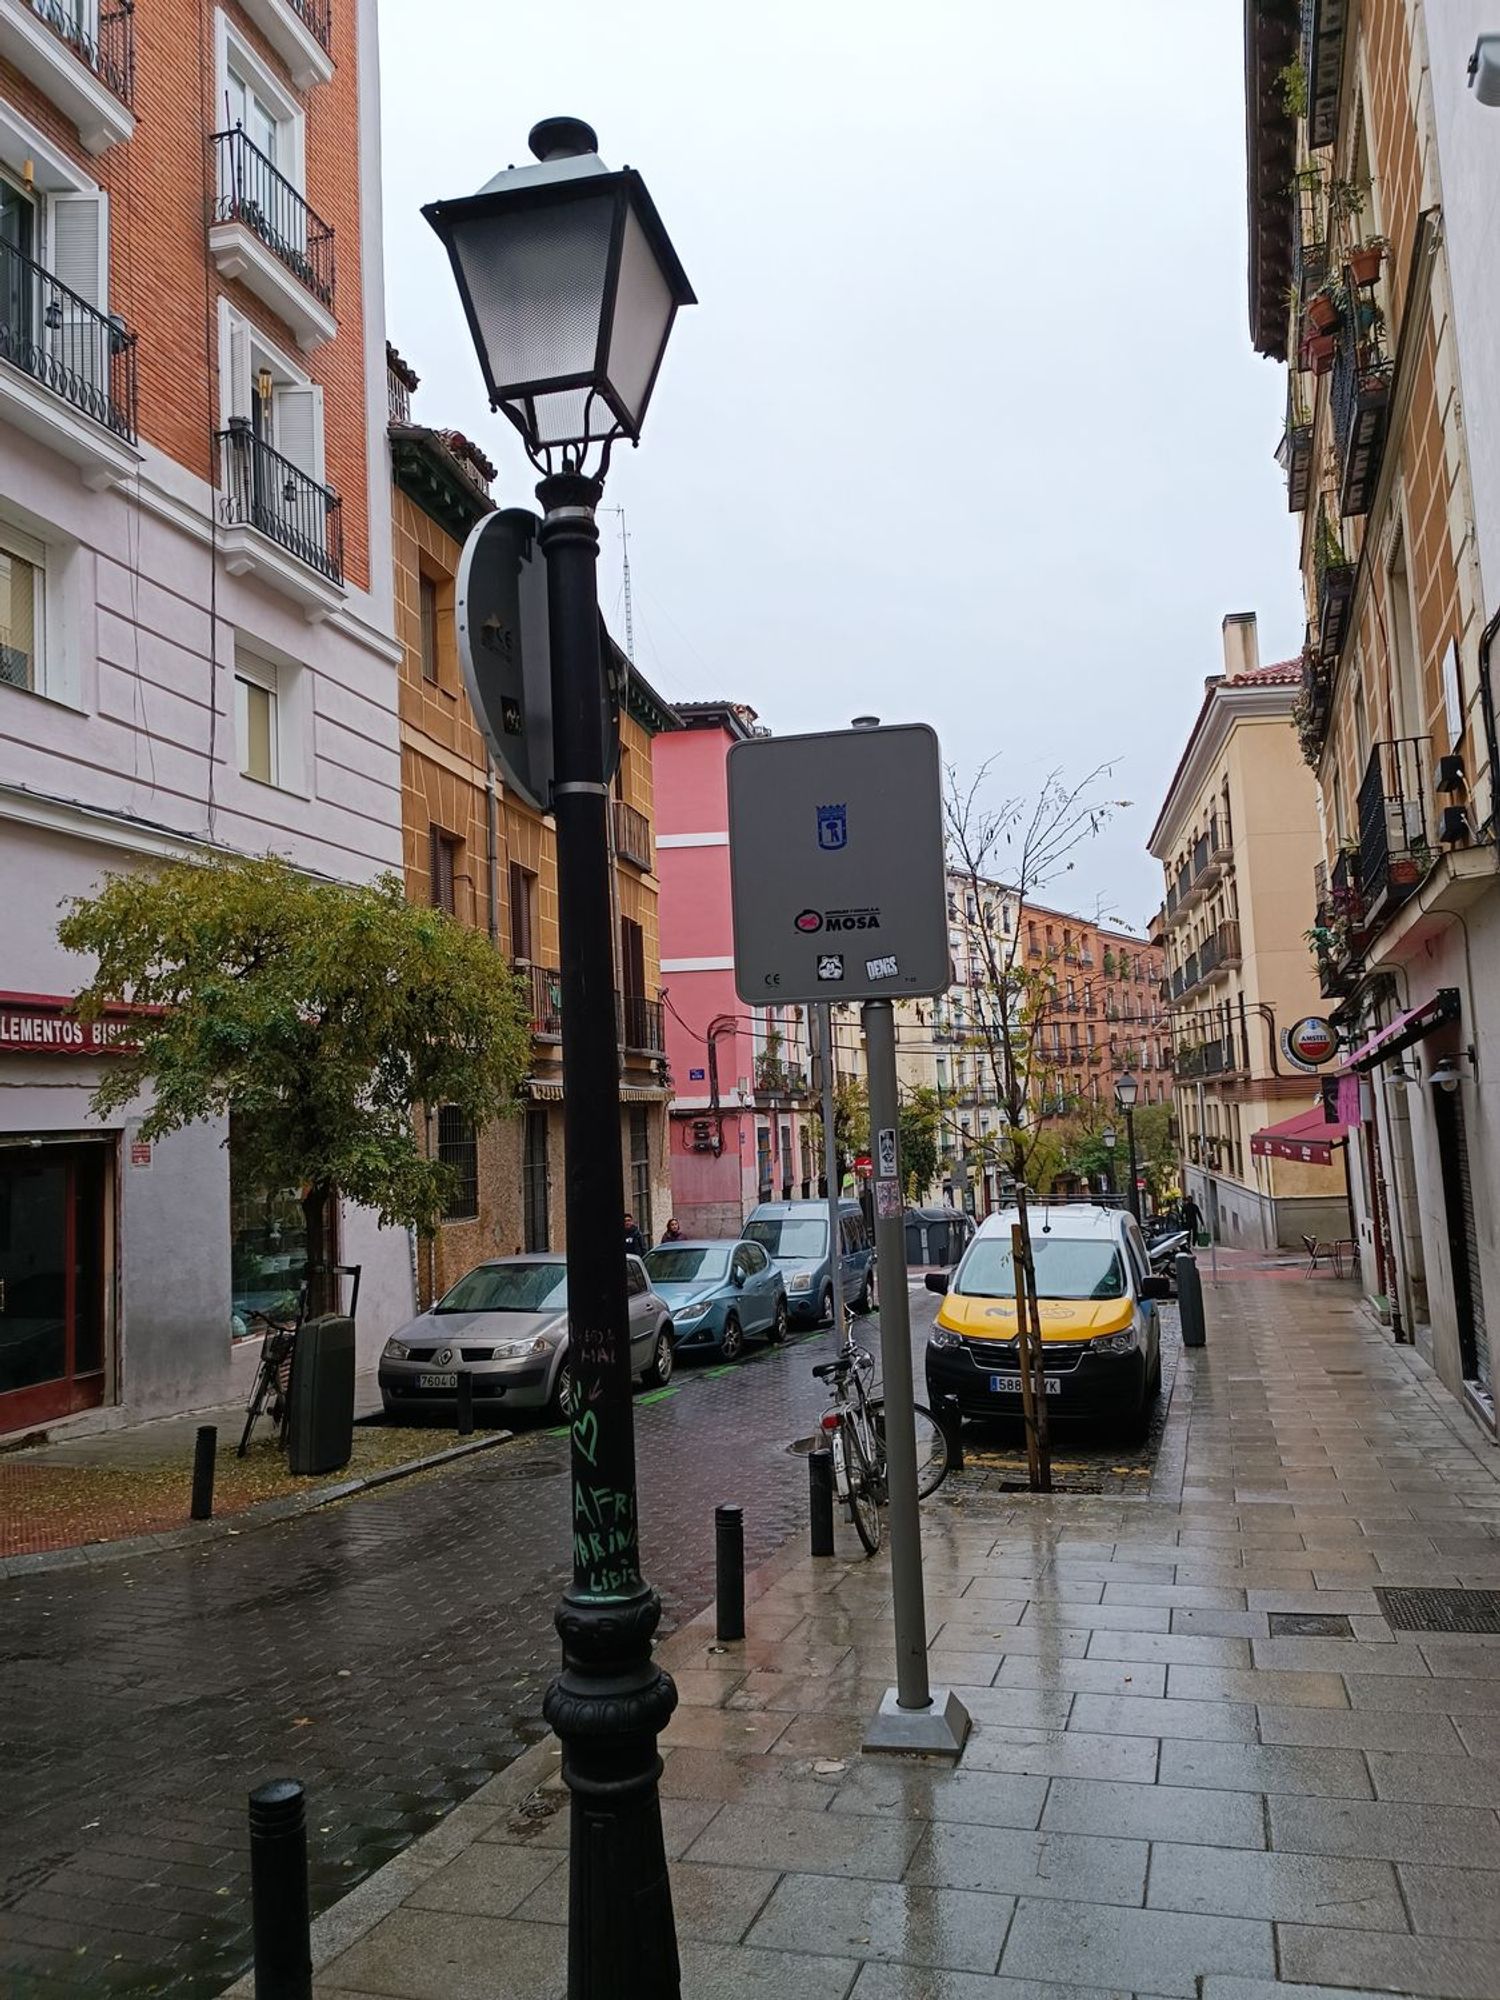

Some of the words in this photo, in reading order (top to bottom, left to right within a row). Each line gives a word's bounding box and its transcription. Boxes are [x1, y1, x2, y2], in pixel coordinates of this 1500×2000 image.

[825, 916, 881, 932] MOSA
[764, 973, 781, 986] CE
[0, 1015, 83, 1044] LEMENTOS
[421, 1375, 447, 1386] 7604
